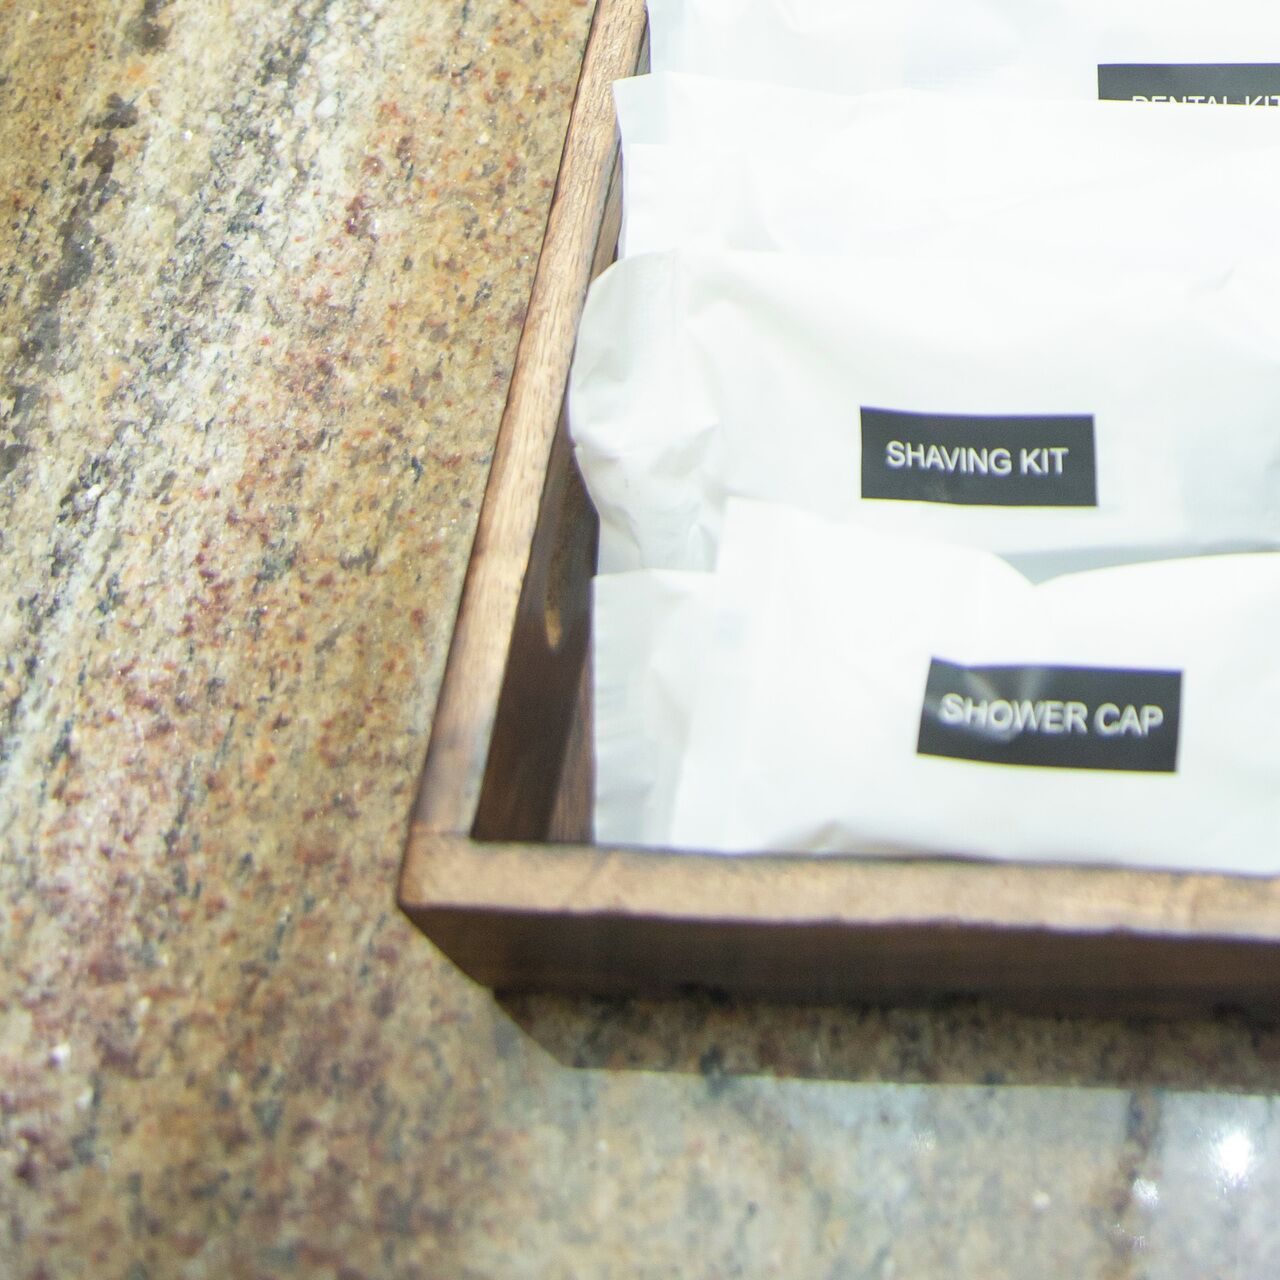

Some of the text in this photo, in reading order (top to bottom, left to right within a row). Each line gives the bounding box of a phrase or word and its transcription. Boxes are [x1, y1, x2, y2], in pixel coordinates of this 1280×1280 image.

[885, 439, 1069, 476] SHAVING KIT
[937, 692, 1164, 737] SHOWER CAP
